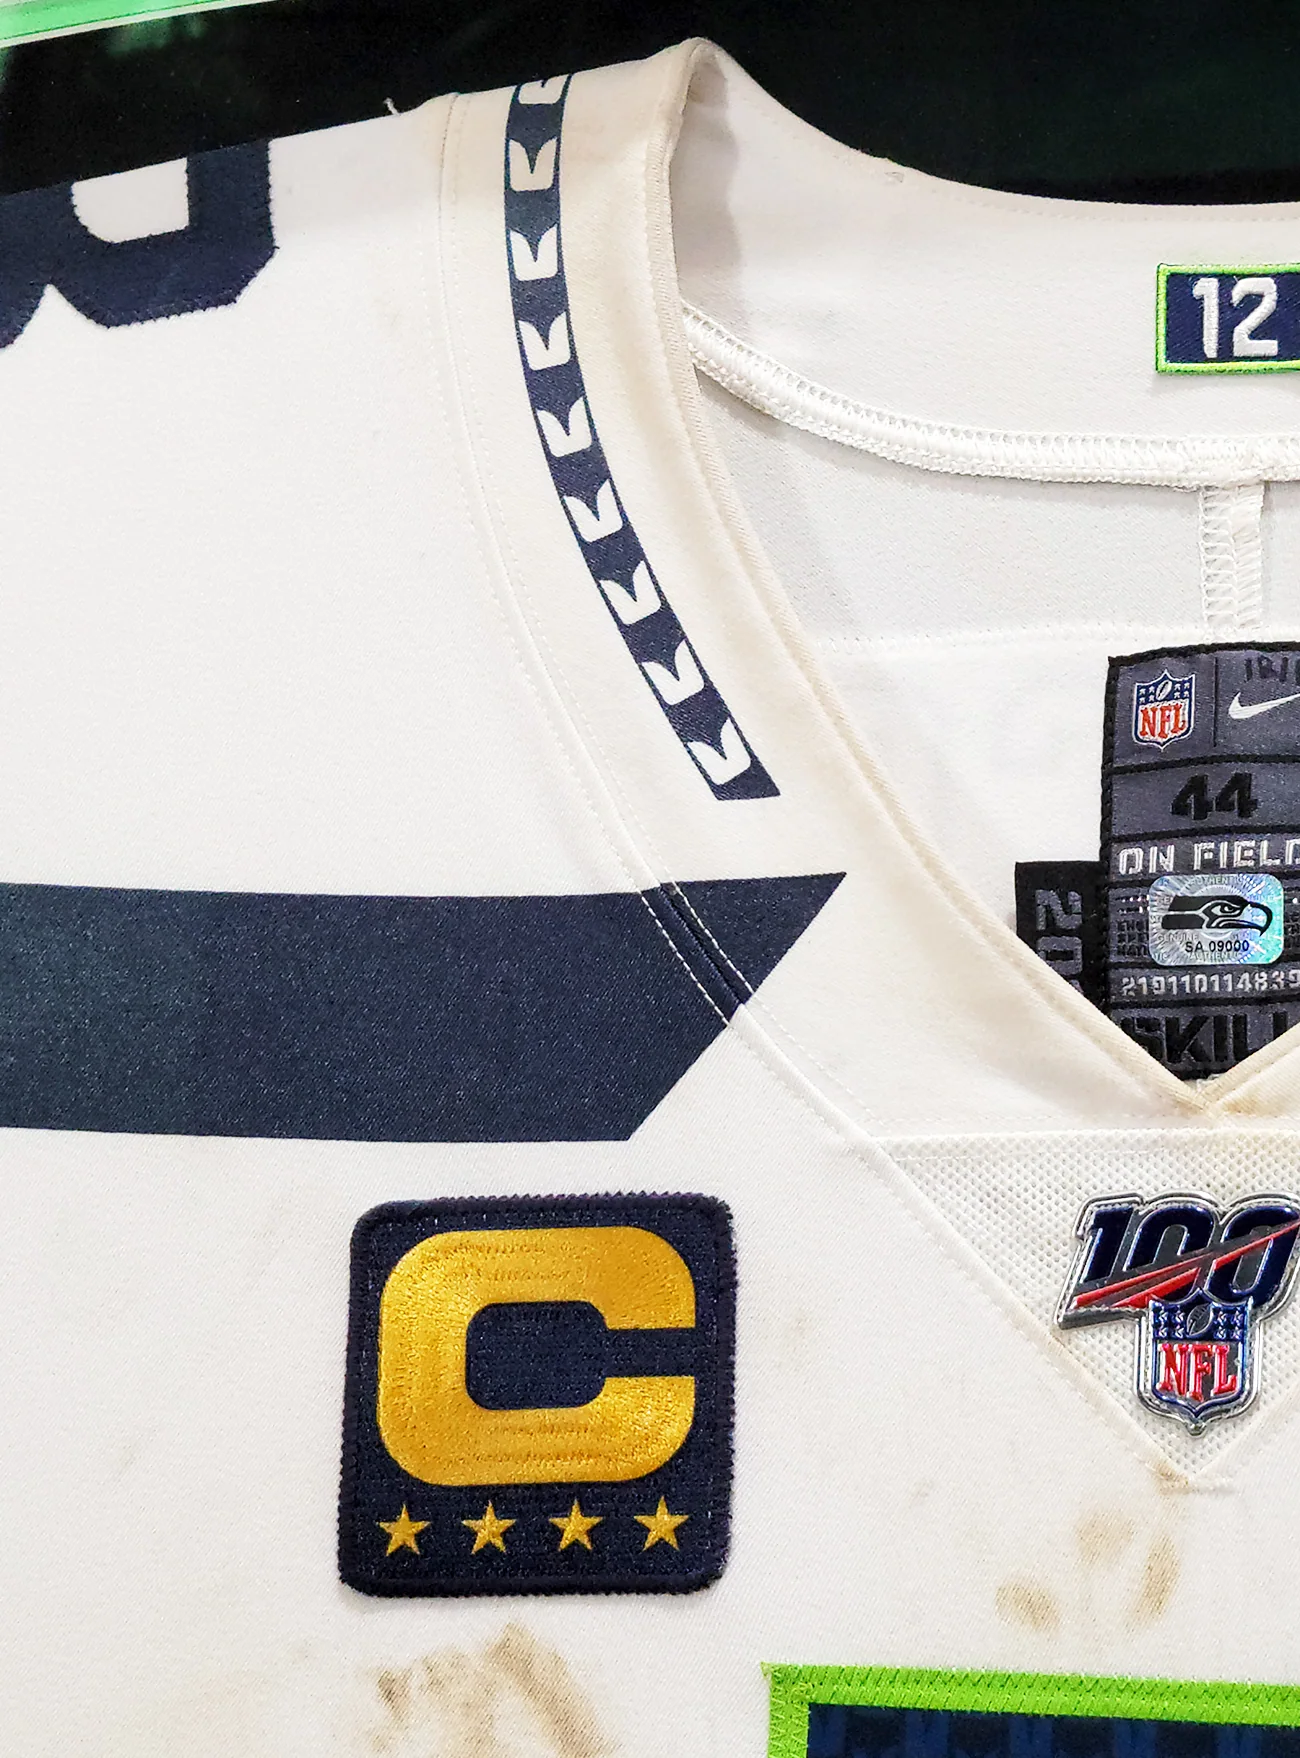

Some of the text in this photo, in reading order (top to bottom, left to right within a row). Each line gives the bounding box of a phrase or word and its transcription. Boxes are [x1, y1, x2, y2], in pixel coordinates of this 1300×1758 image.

[1192, 276, 1279, 359] 12
[1138, 701, 1187, 740] NFL
[1170, 771, 1259, 821] 44
[1118, 843, 1177, 875] ON
[1035, 888, 1084, 995] 20
[1184, 938, 1250, 953] SA 09000
[376, 1225, 696, 1487] C
[1153, 1341, 1238, 1401] NFL
